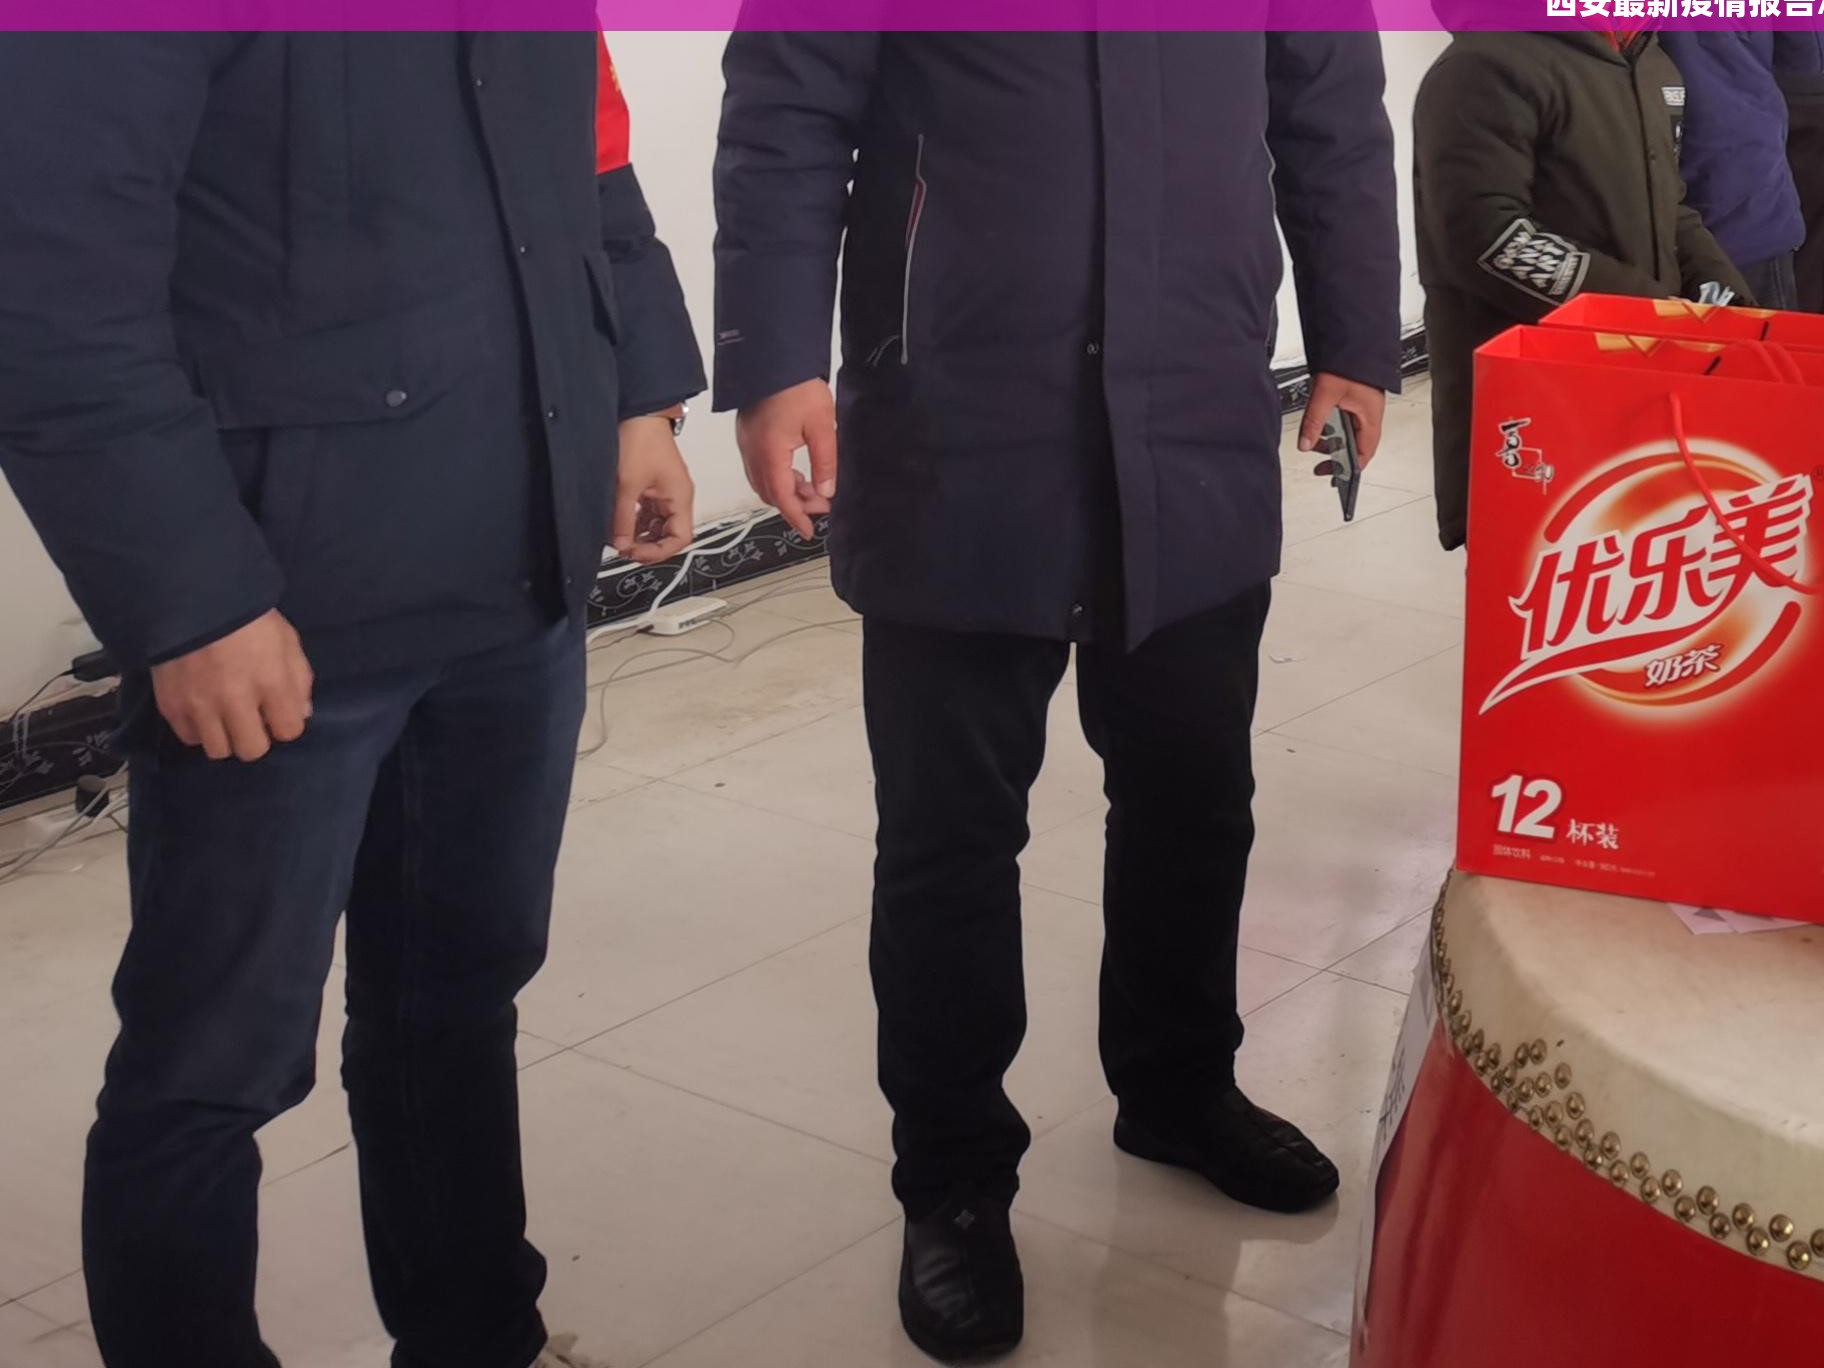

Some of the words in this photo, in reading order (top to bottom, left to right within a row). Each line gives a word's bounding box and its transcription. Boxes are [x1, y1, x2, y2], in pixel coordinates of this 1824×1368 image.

[1510, 478, 1812, 658] 优乐美
[1645, 643, 1723, 688] 奶茶
[1491, 774, 1562, 839] 12
[1566, 818, 1619, 850] 杯装
